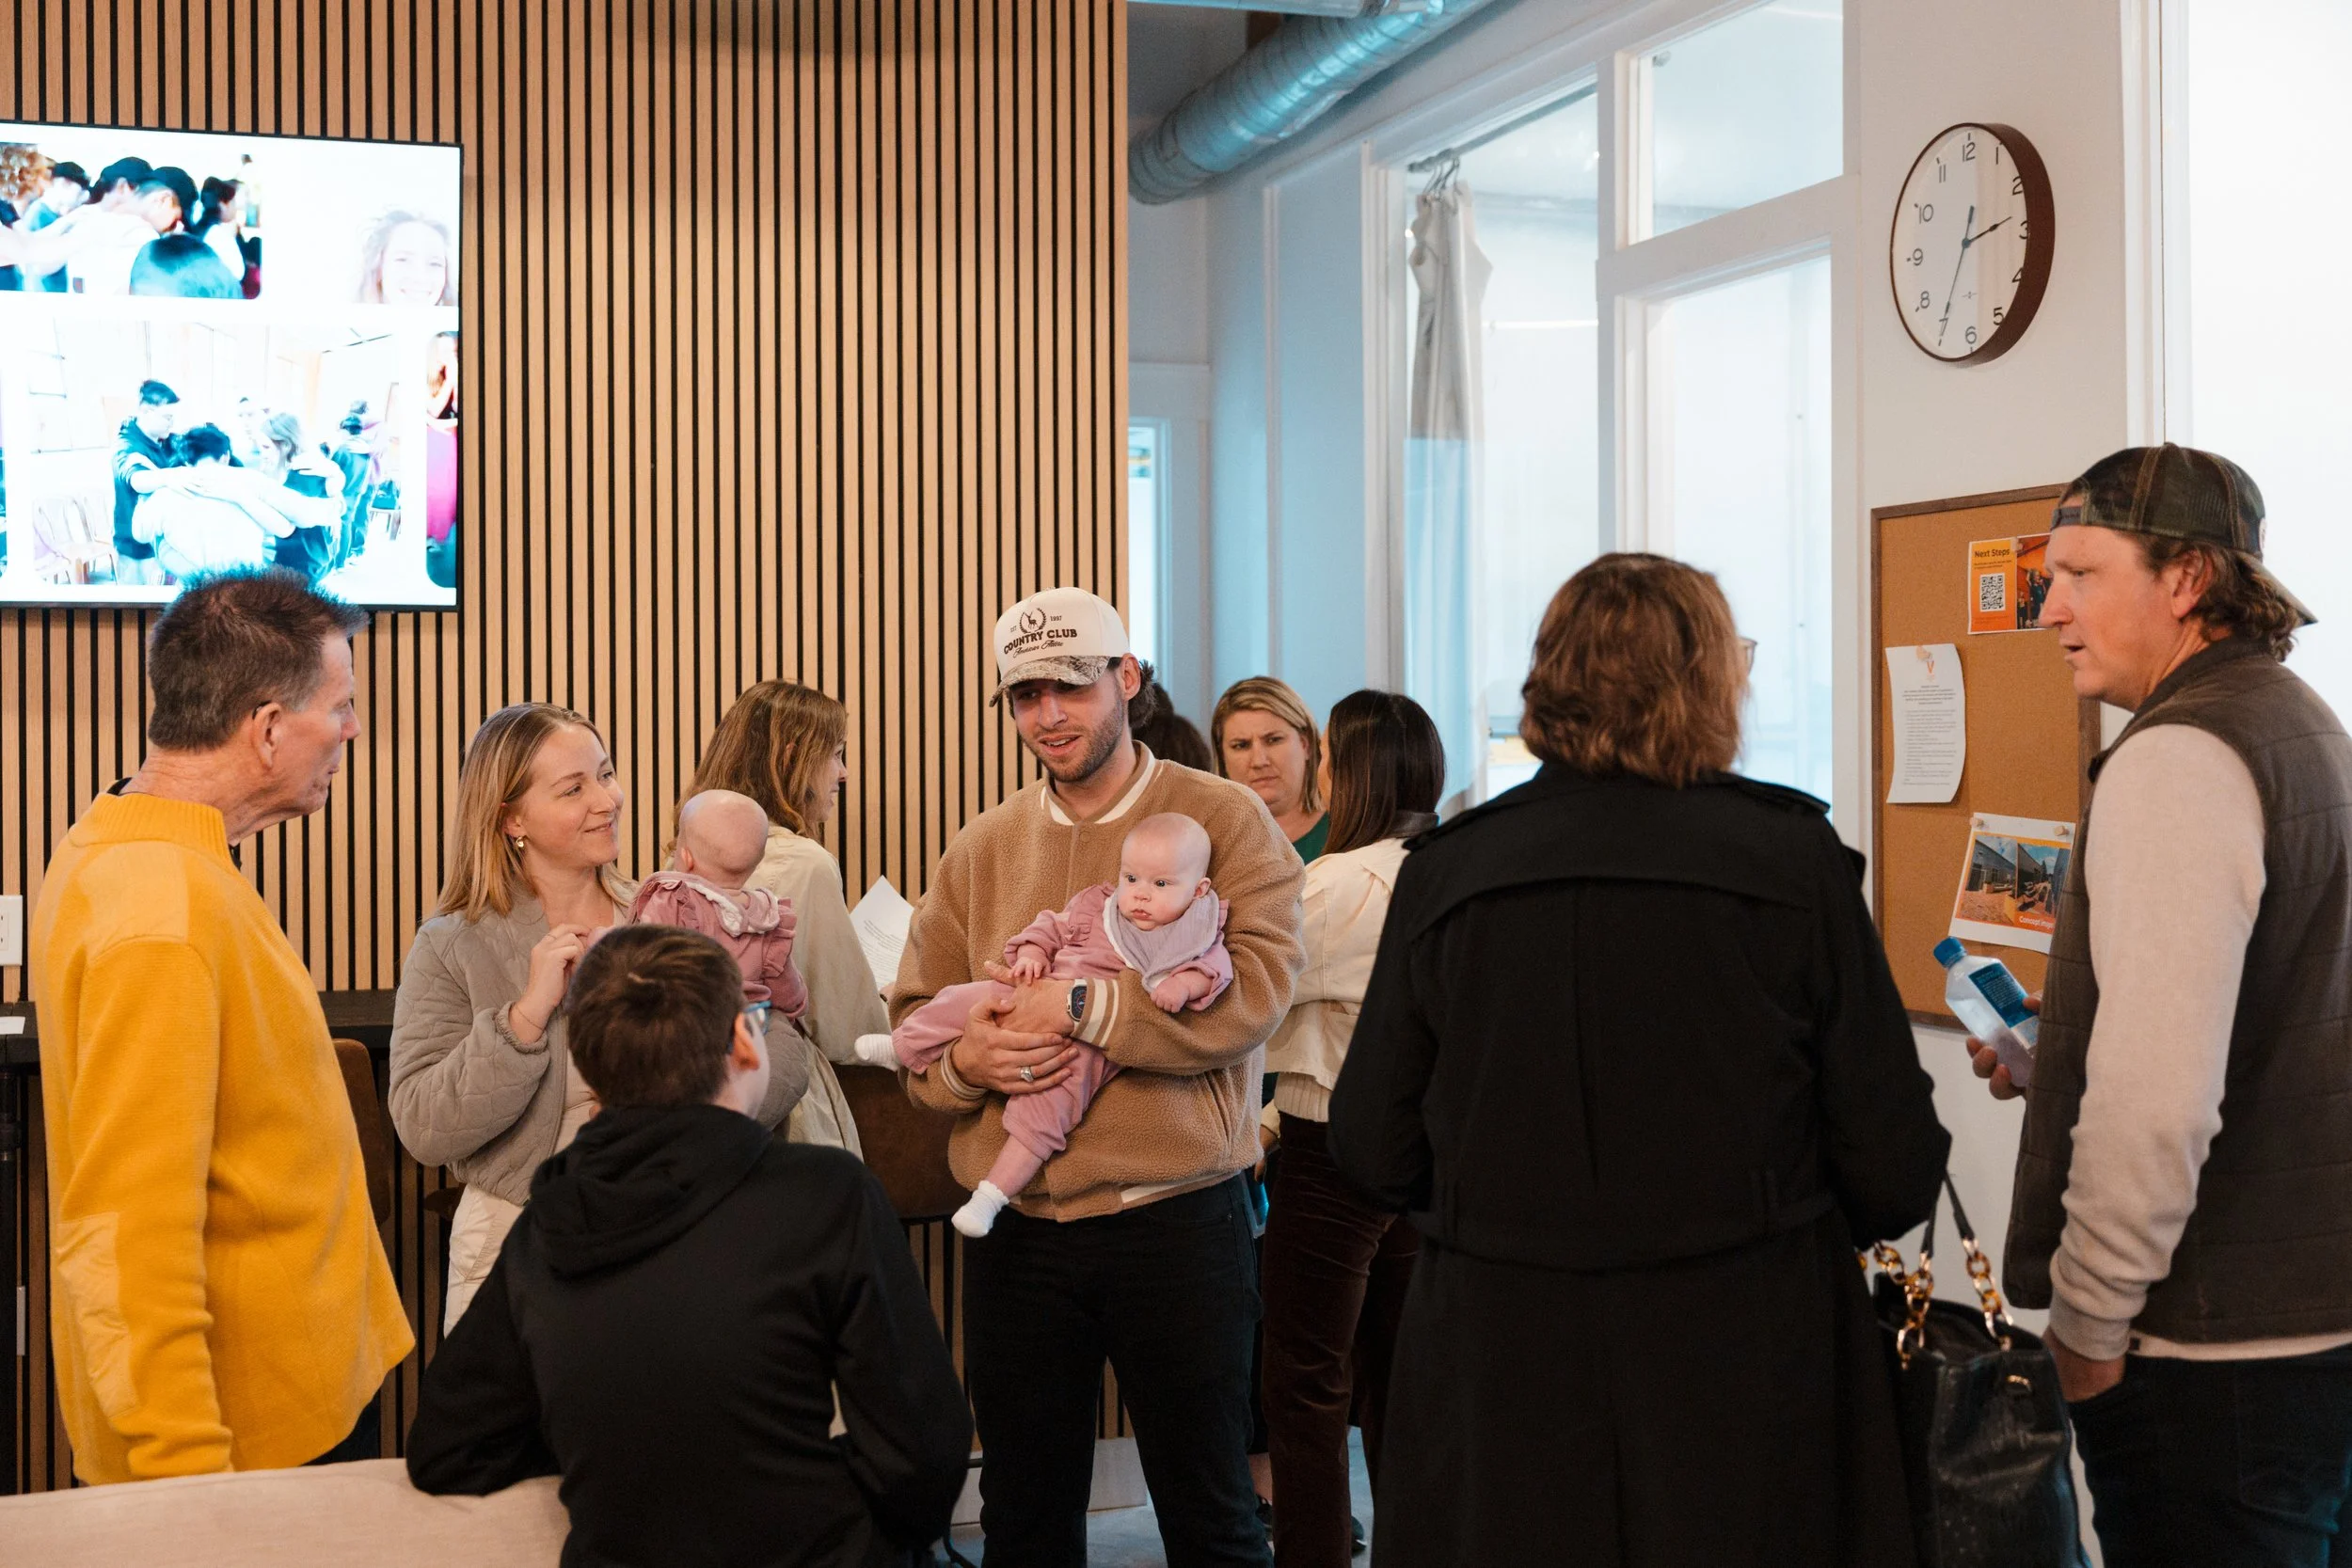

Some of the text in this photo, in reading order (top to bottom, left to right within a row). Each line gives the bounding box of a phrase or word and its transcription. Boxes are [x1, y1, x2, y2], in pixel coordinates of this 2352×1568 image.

[1963, 142, 1976, 162] 12
[1939, 164, 1947, 183] 11
[2011, 176, 2023, 196] 2
[1918, 203, 1934, 224] 10
[2019, 220, 2028, 240] 3
[1912, 248, 1924, 266] 9
[1920, 291, 1931, 309] 8
[1993, 307, 2005, 326] 5
[1939, 317, 1948, 337] 7
[1965, 325, 1978, 344] 6
[1992, 548, 2010, 558] Steps
[1004, 628, 1077, 655] COUNTRY CLUB
